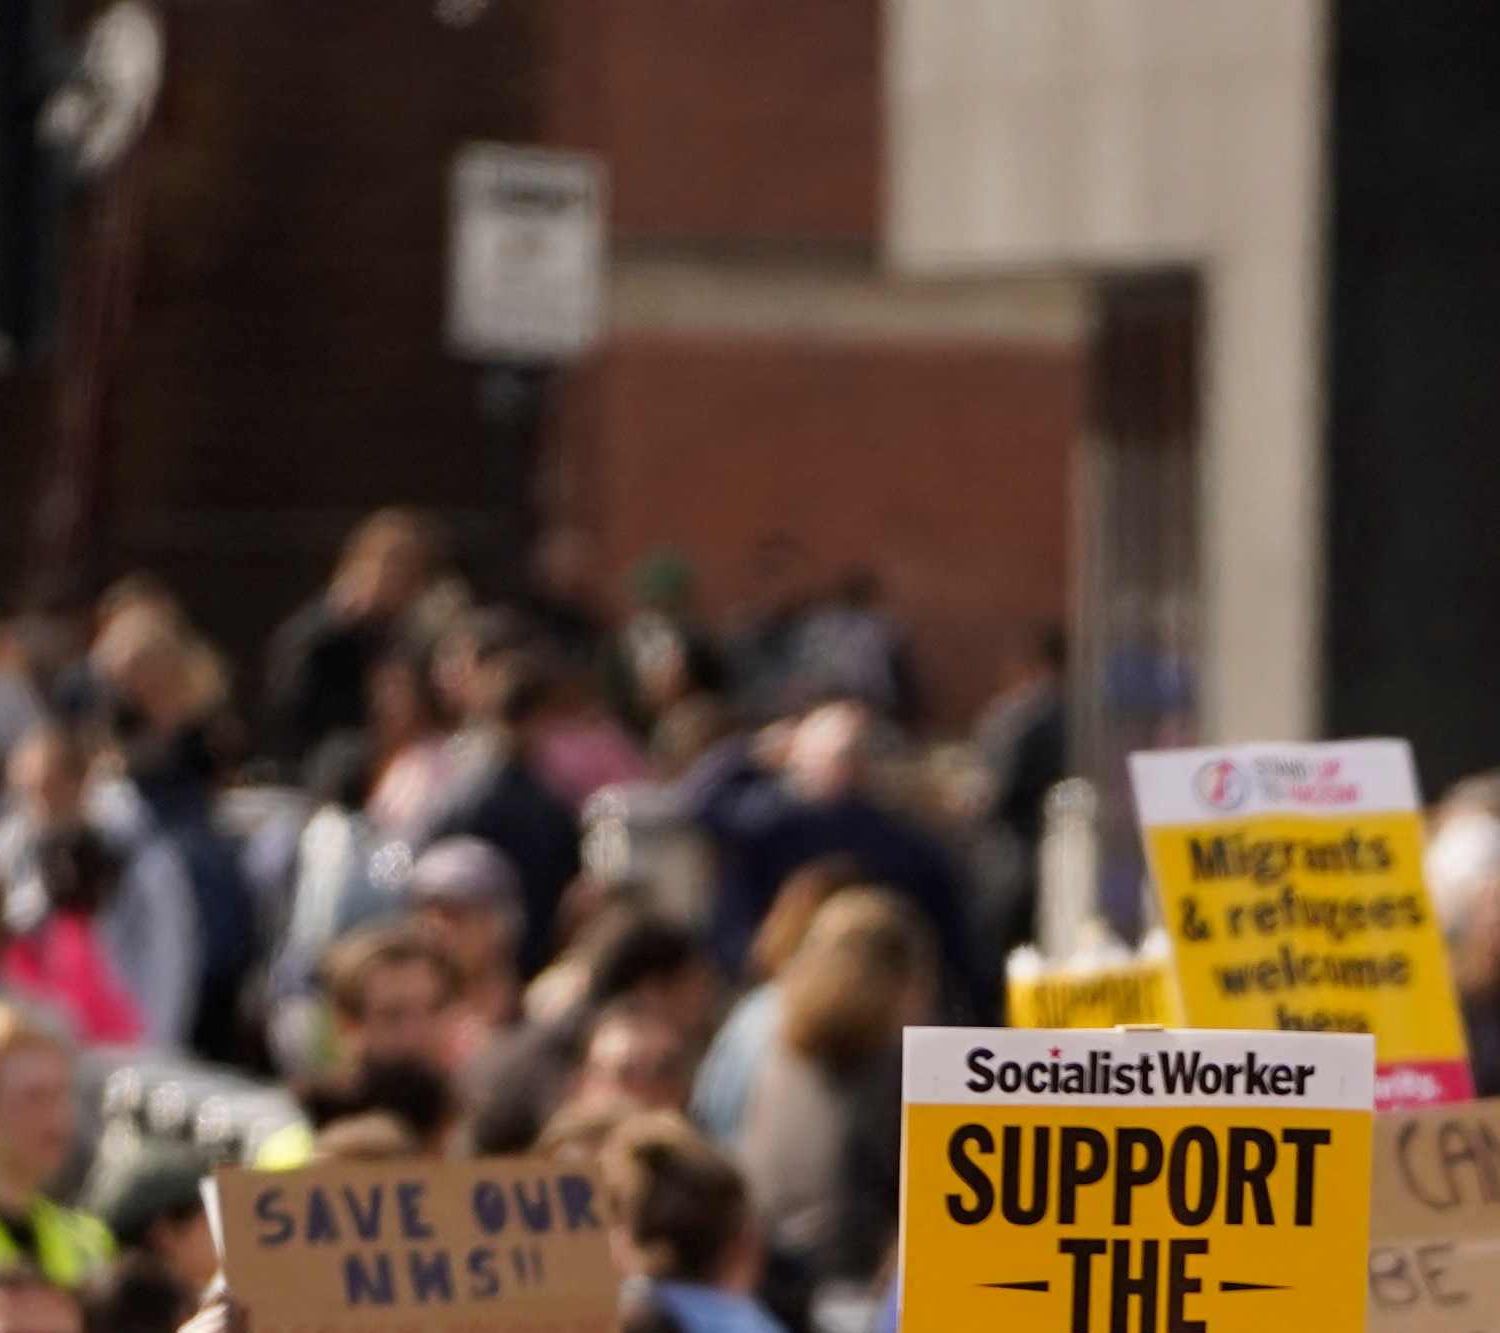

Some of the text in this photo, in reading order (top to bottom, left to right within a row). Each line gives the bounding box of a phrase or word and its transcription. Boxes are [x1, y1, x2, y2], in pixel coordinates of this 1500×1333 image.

[1185, 832, 1393, 887] Migrants
[1179, 884, 1425, 943] & refugees
[1215, 947, 1410, 998] welcome
[965, 1047, 1315, 1097] Socialist Worker
[945, 1123, 1332, 1227] SUPPORT
[255, 1173, 601, 1247] SAVE OUR
[1369, 1242, 1471, 1308] BE
